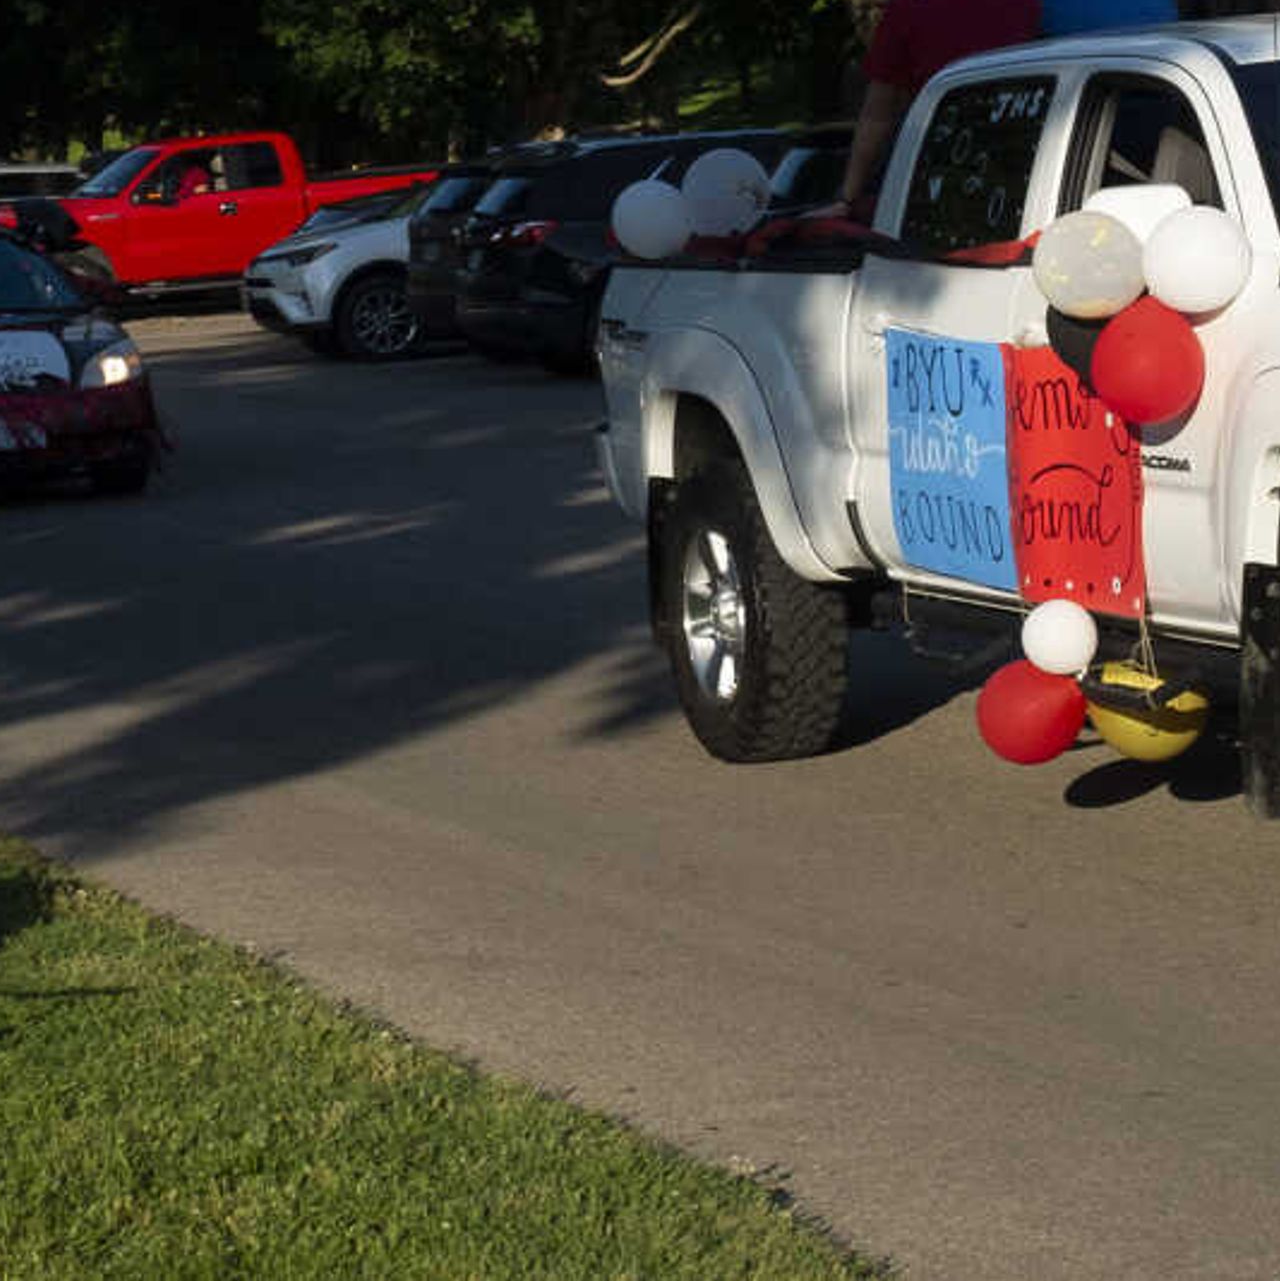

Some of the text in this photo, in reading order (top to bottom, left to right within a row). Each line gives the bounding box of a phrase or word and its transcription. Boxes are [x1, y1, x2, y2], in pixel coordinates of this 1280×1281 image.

[905, 342, 965, 417] BYU
[1140, 454, 1191, 472] ACOMA
[897, 489, 1005, 564] BOUND
[1018, 463, 1121, 548] ound
